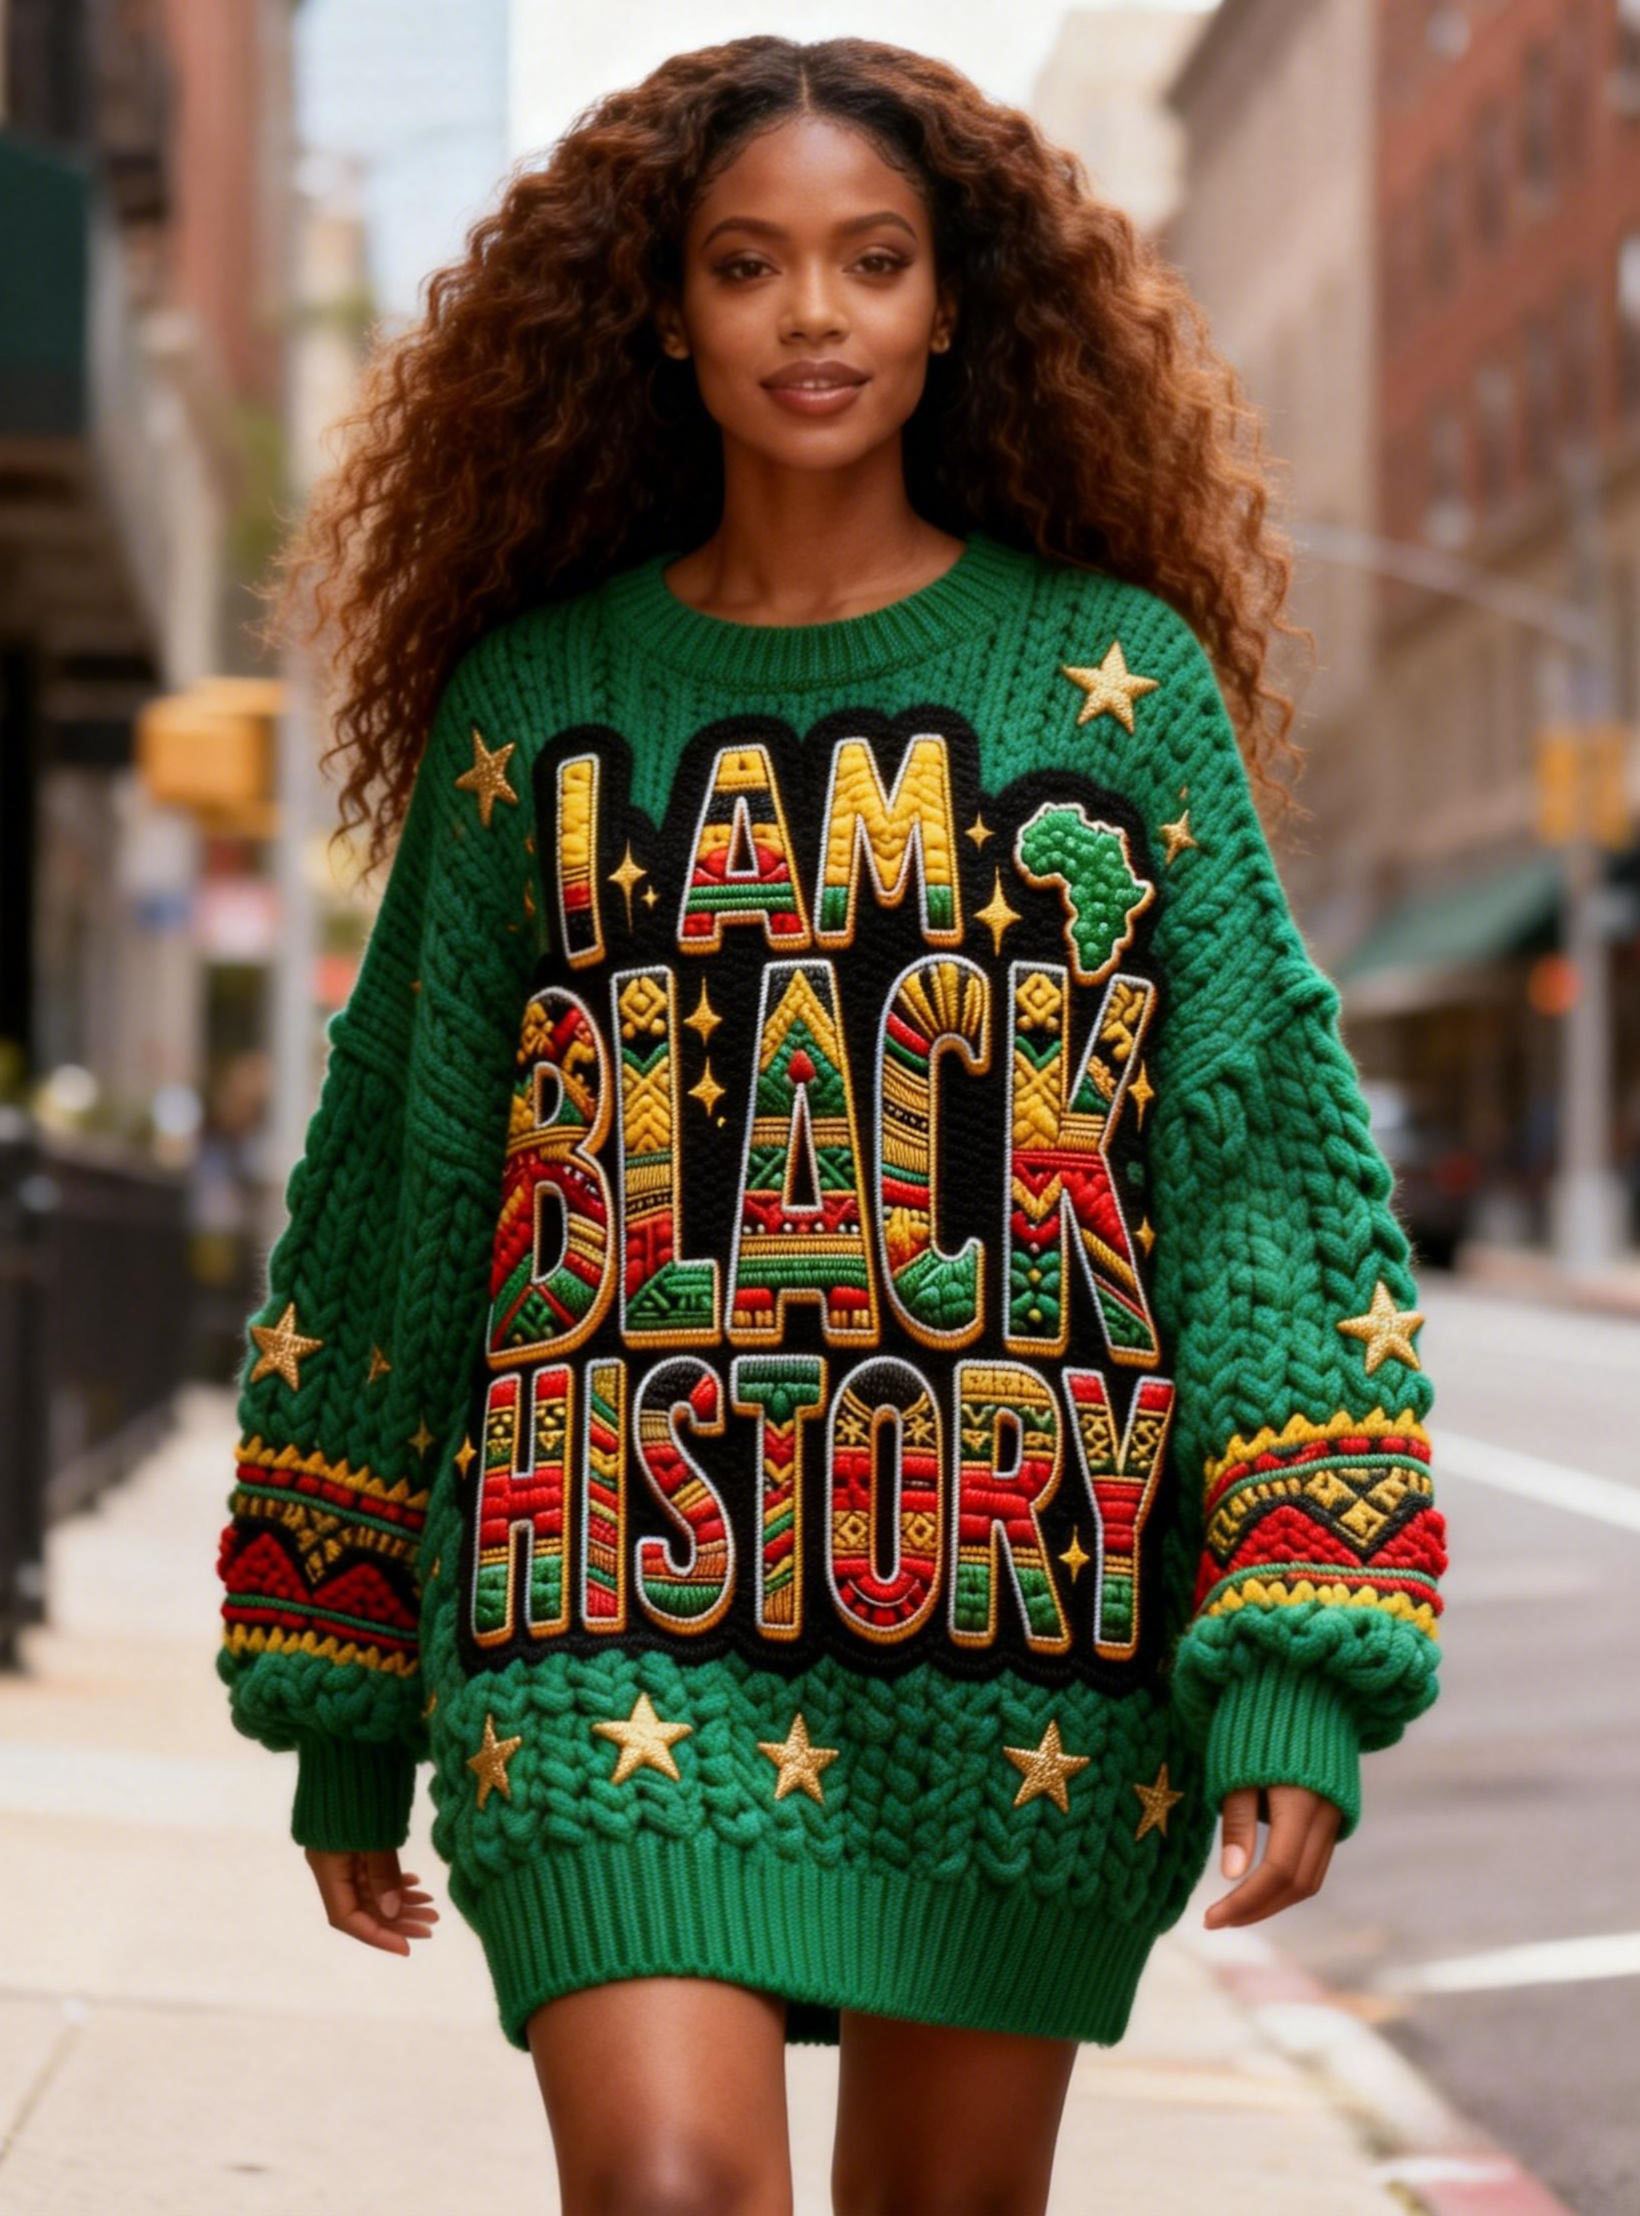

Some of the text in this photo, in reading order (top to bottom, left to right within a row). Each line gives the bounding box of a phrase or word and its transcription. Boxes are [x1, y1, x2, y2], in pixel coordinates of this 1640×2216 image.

[555, 733, 964, 968] I AM
[486, 953, 1161, 1366] BLACK
[471, 1354, 1176, 1660] HISTORY
